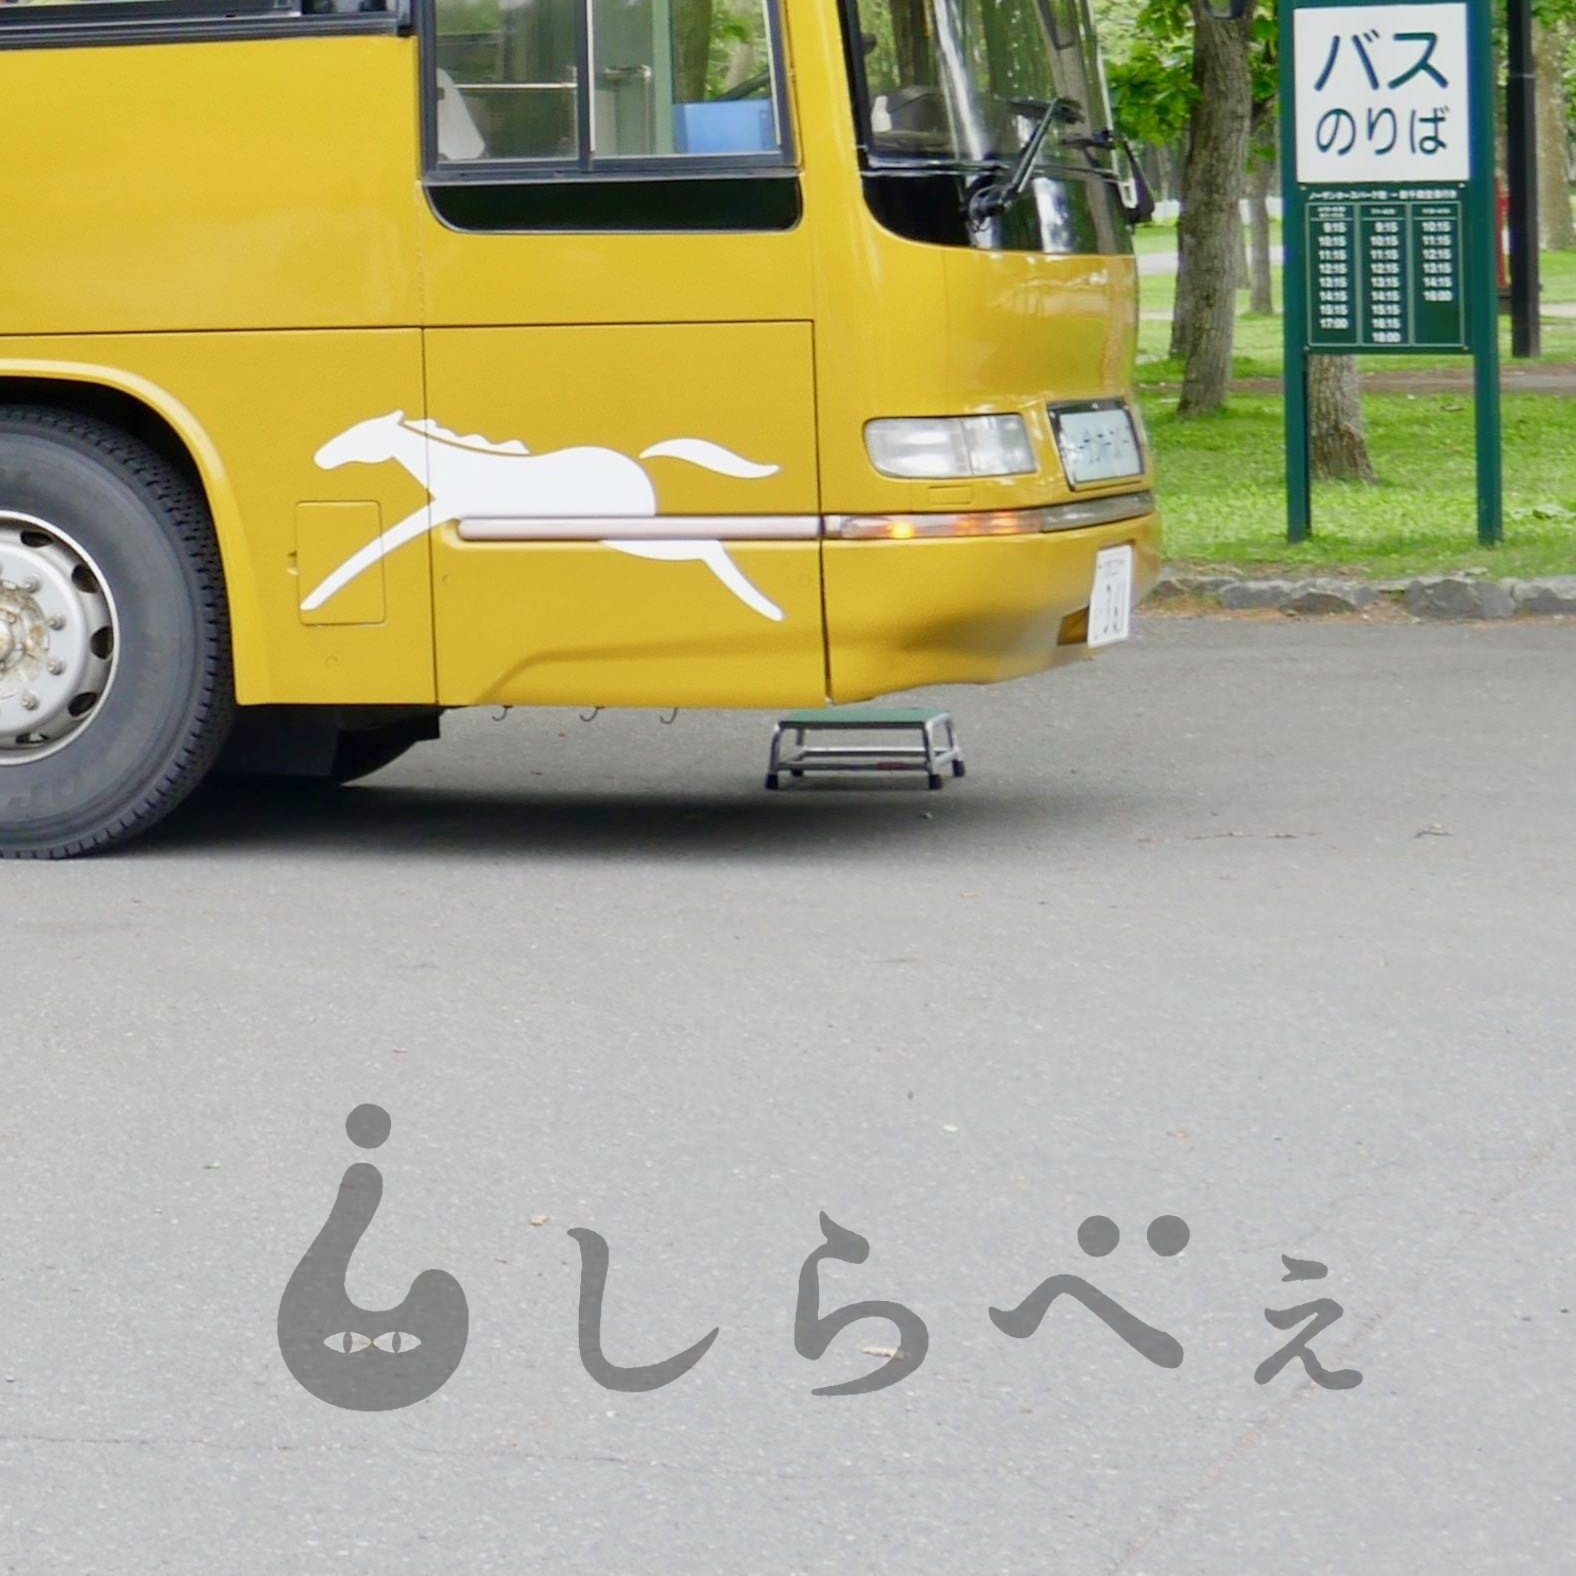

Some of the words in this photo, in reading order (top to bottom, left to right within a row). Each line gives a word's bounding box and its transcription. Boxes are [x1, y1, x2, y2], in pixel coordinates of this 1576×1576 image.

[1314, 28, 1449, 92] バス
[1315, 105, 1448, 156] のりば
